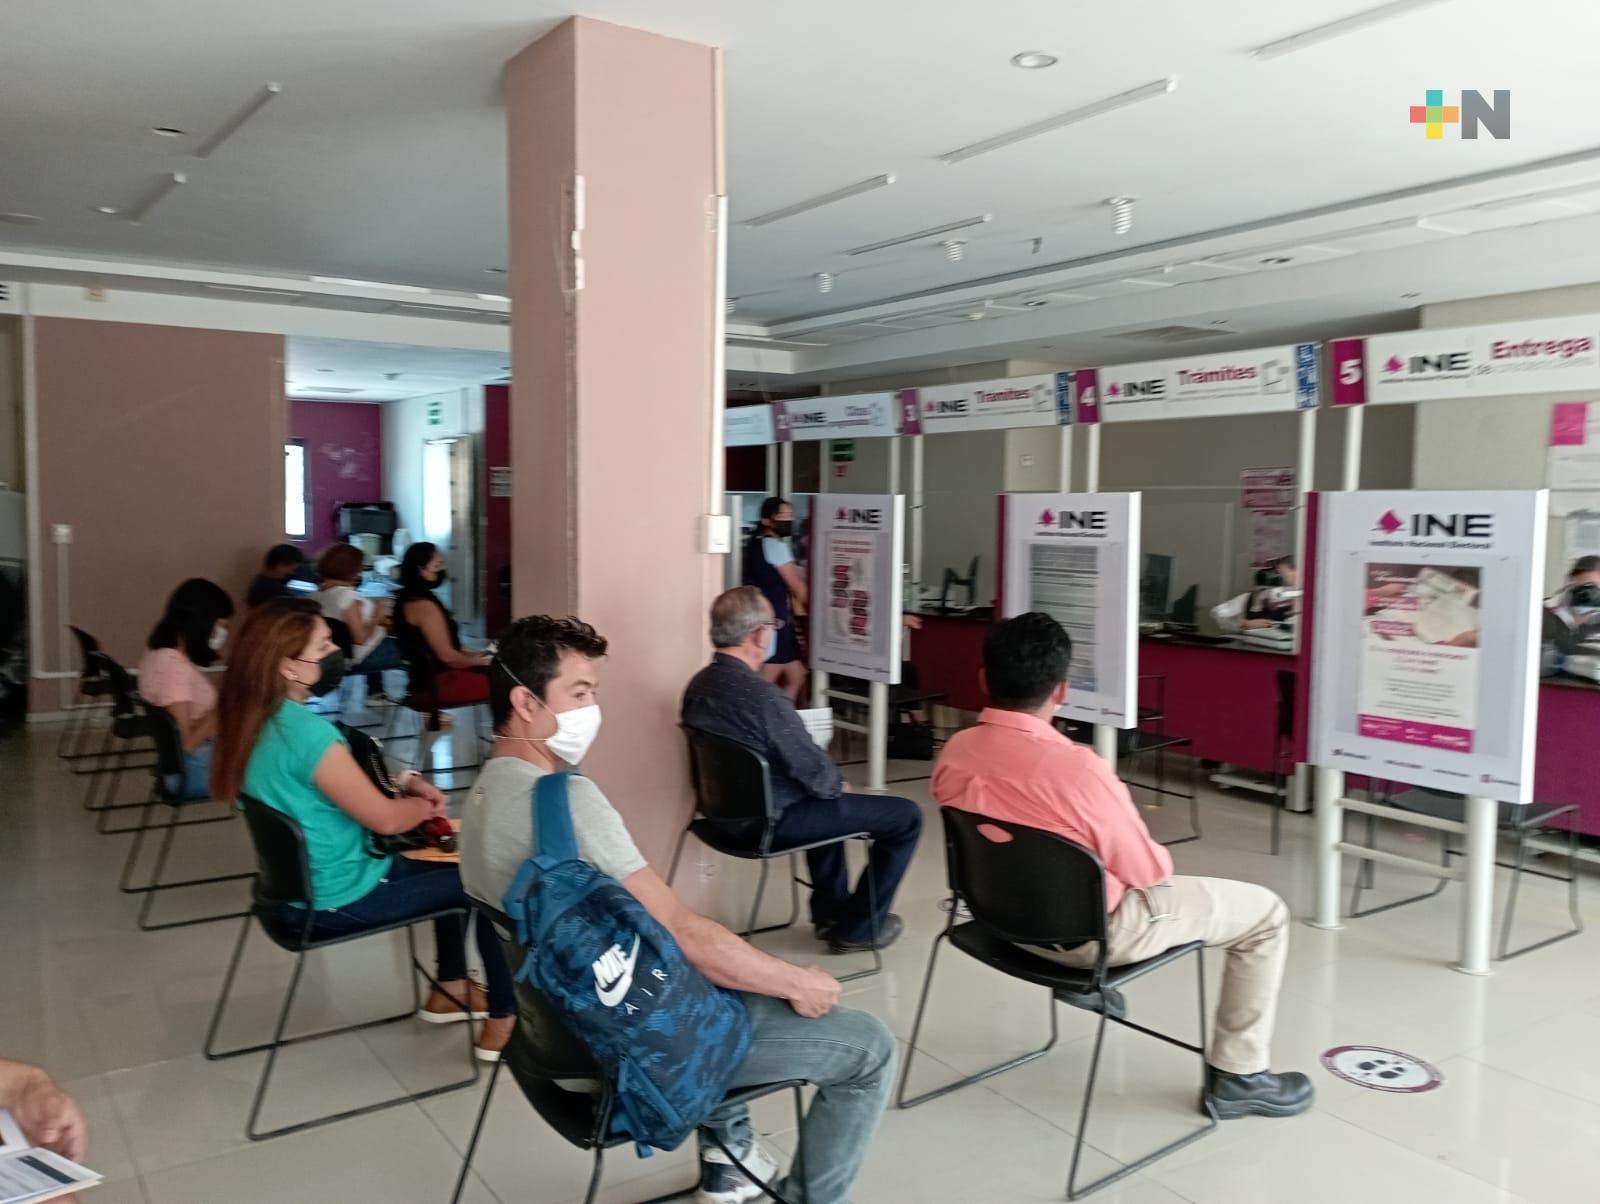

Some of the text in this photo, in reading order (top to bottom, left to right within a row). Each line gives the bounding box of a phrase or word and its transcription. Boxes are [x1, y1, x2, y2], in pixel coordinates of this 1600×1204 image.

[1491, 337, 1592, 359] Entrega
[1339, 359, 1362, 385] 5
[1409, 351, 1471, 374] INE
[1080, 386, 1097, 407] 4
[1122, 379, 1165, 397] INE
[904, 404, 916, 422] 3
[849, 508, 882, 524] INE
[1058, 510, 1108, 529] INE
[1410, 513, 1495, 538] INE
